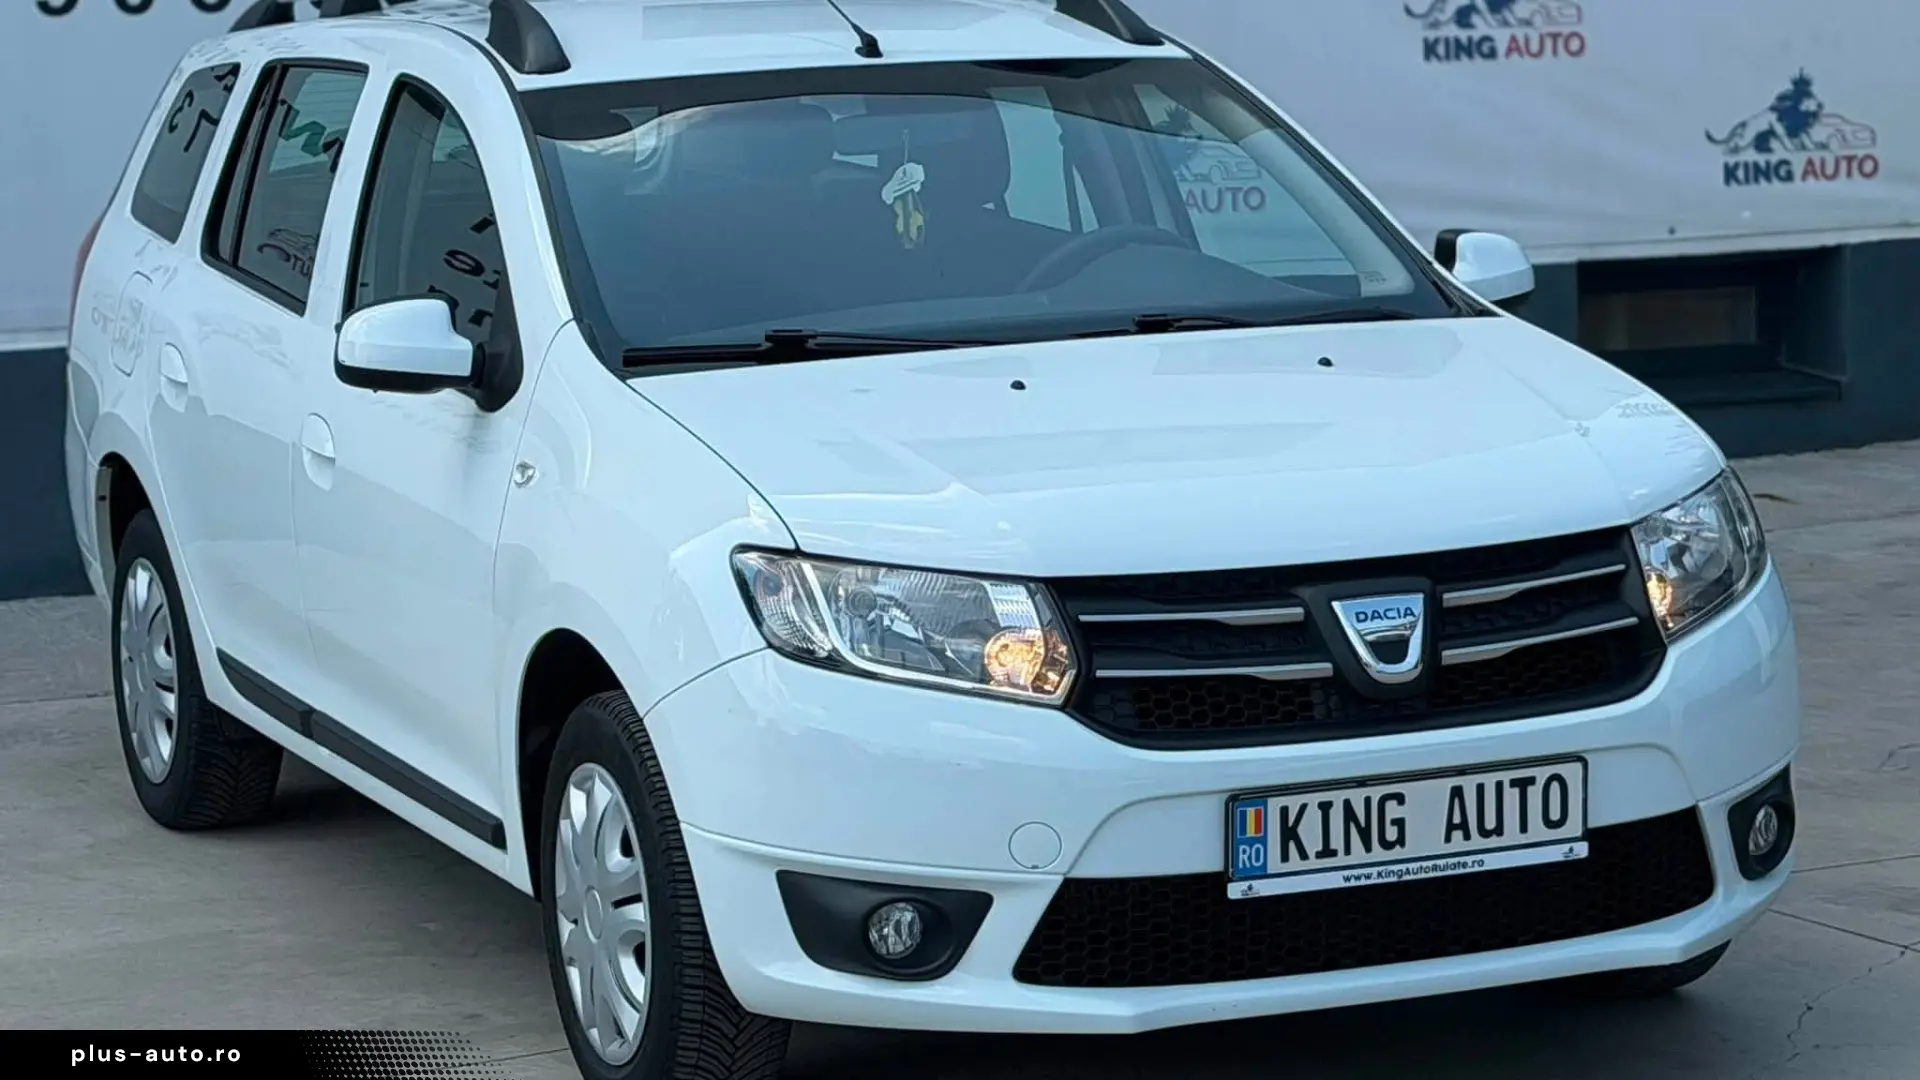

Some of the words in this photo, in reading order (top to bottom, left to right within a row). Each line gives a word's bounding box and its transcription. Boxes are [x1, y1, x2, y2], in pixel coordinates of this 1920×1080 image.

[1422, 35, 1498, 62] KING
[1504, 31, 1587, 60] AUTO
[1723, 158, 1795, 187] KING
[1801, 153, 1880, 182] AUTO
[1185, 185, 1267, 214] AUTO
[1354, 606, 1417, 624] DACIA
[1278, 791, 1407, 864] KING
[1443, 772, 1569, 845] AUTO
[1238, 842, 1264, 869] RO
[1342, 858, 1486, 884] www.KingAutoRulate.ro
